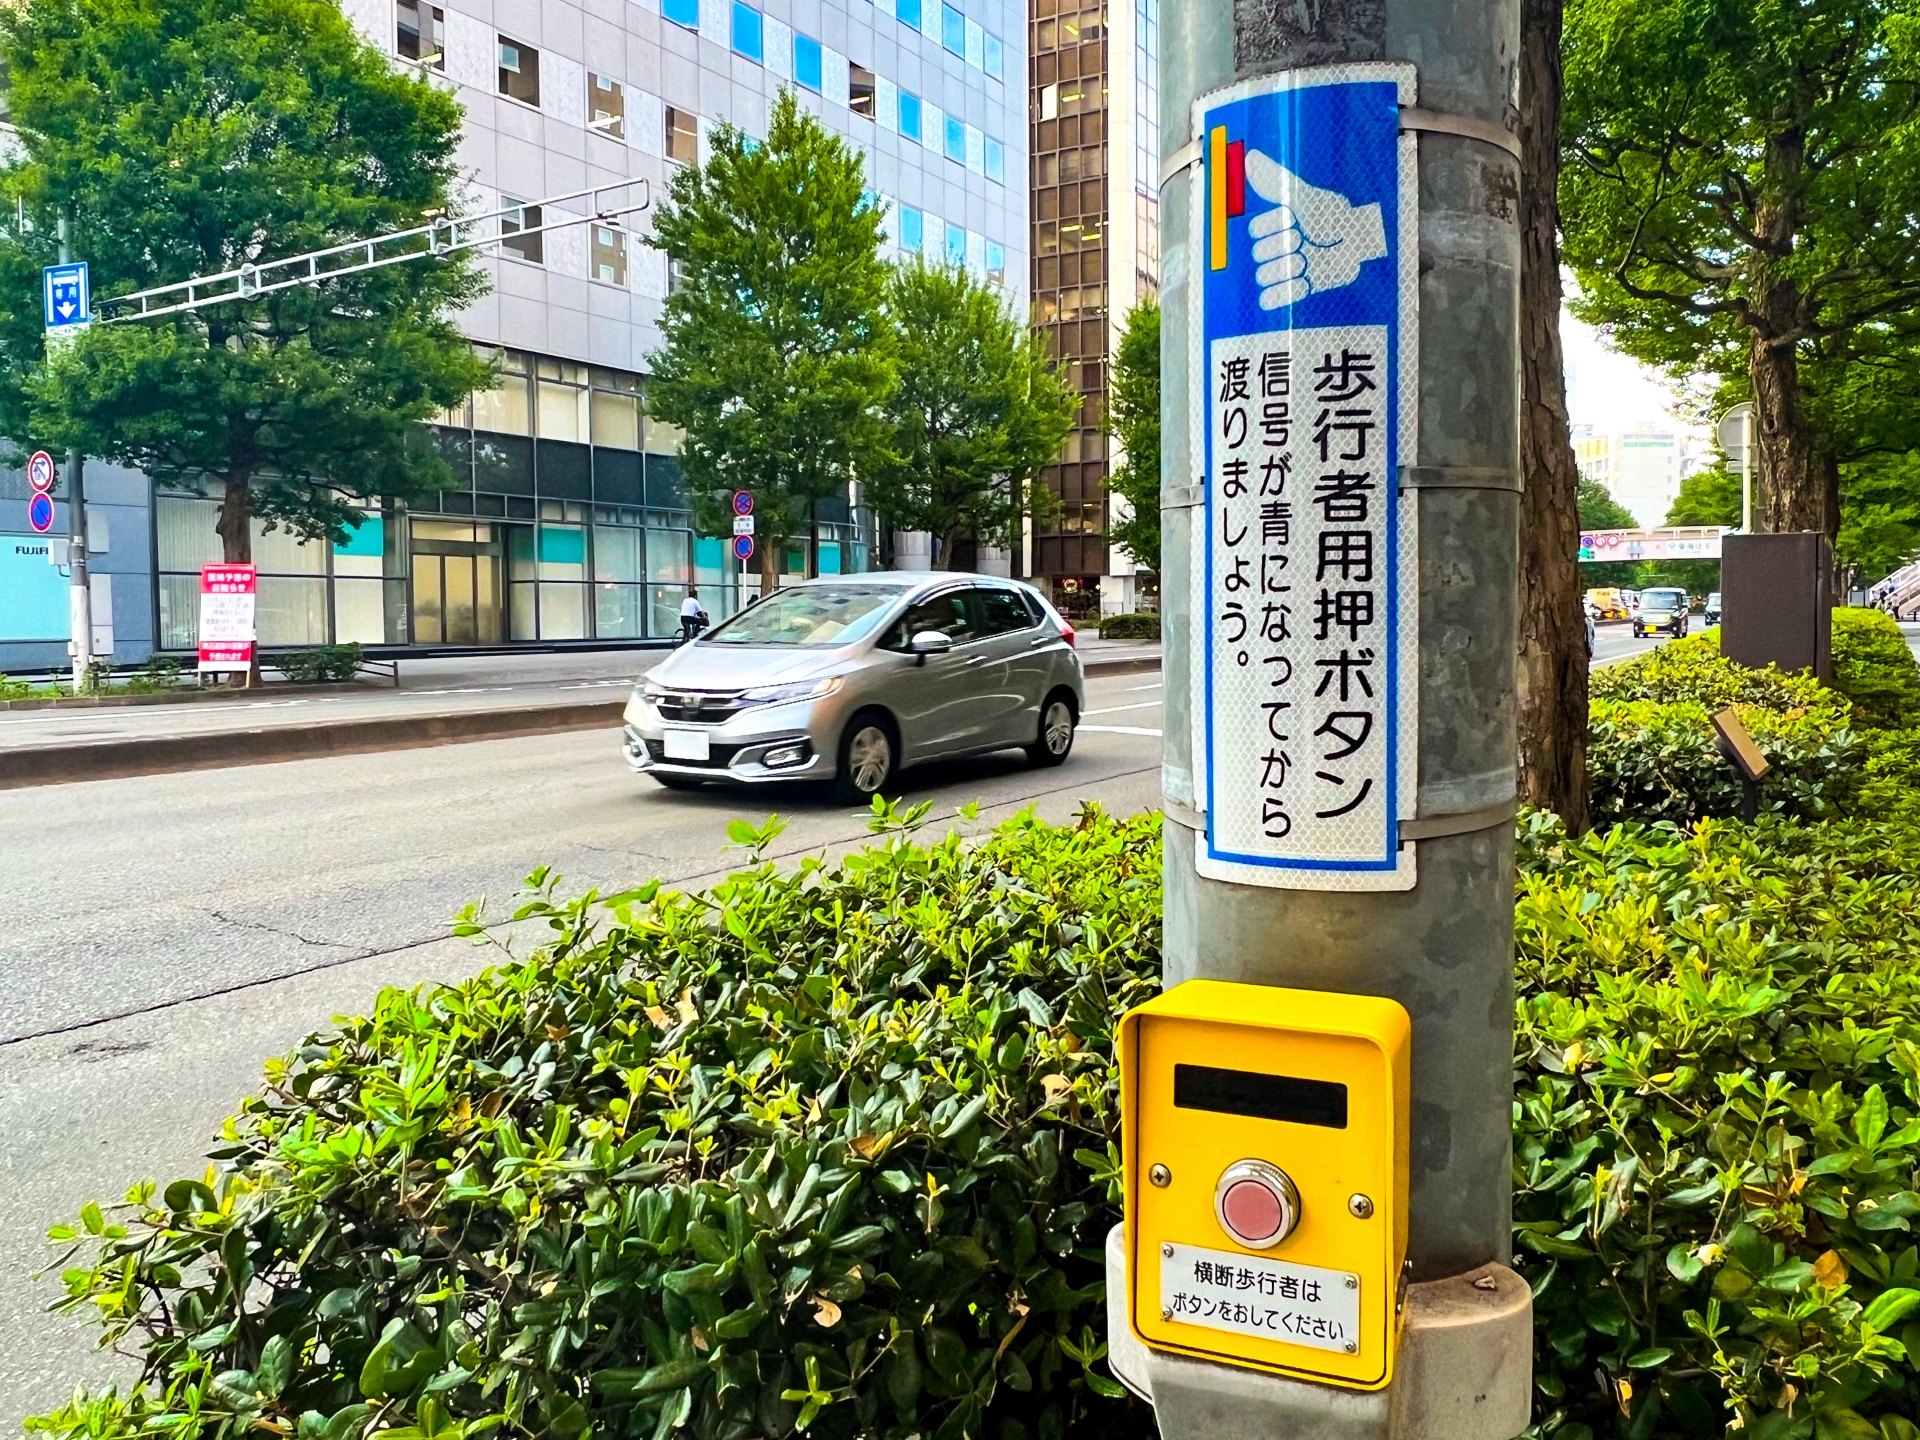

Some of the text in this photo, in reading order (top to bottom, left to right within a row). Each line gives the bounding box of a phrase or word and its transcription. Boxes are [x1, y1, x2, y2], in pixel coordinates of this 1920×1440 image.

[15, 546, 49, 555] FUJIFI
[1219, 356, 1251, 667] 渡りましょう。
[1258, 351, 1293, 838] 信号が青になってから
[1312, 348, 1377, 819] 歩行者用押ボタン
[1172, 1291, 1344, 1340] ボタンをおしてください
[1194, 1260, 1322, 1302] 横断歩行者は
